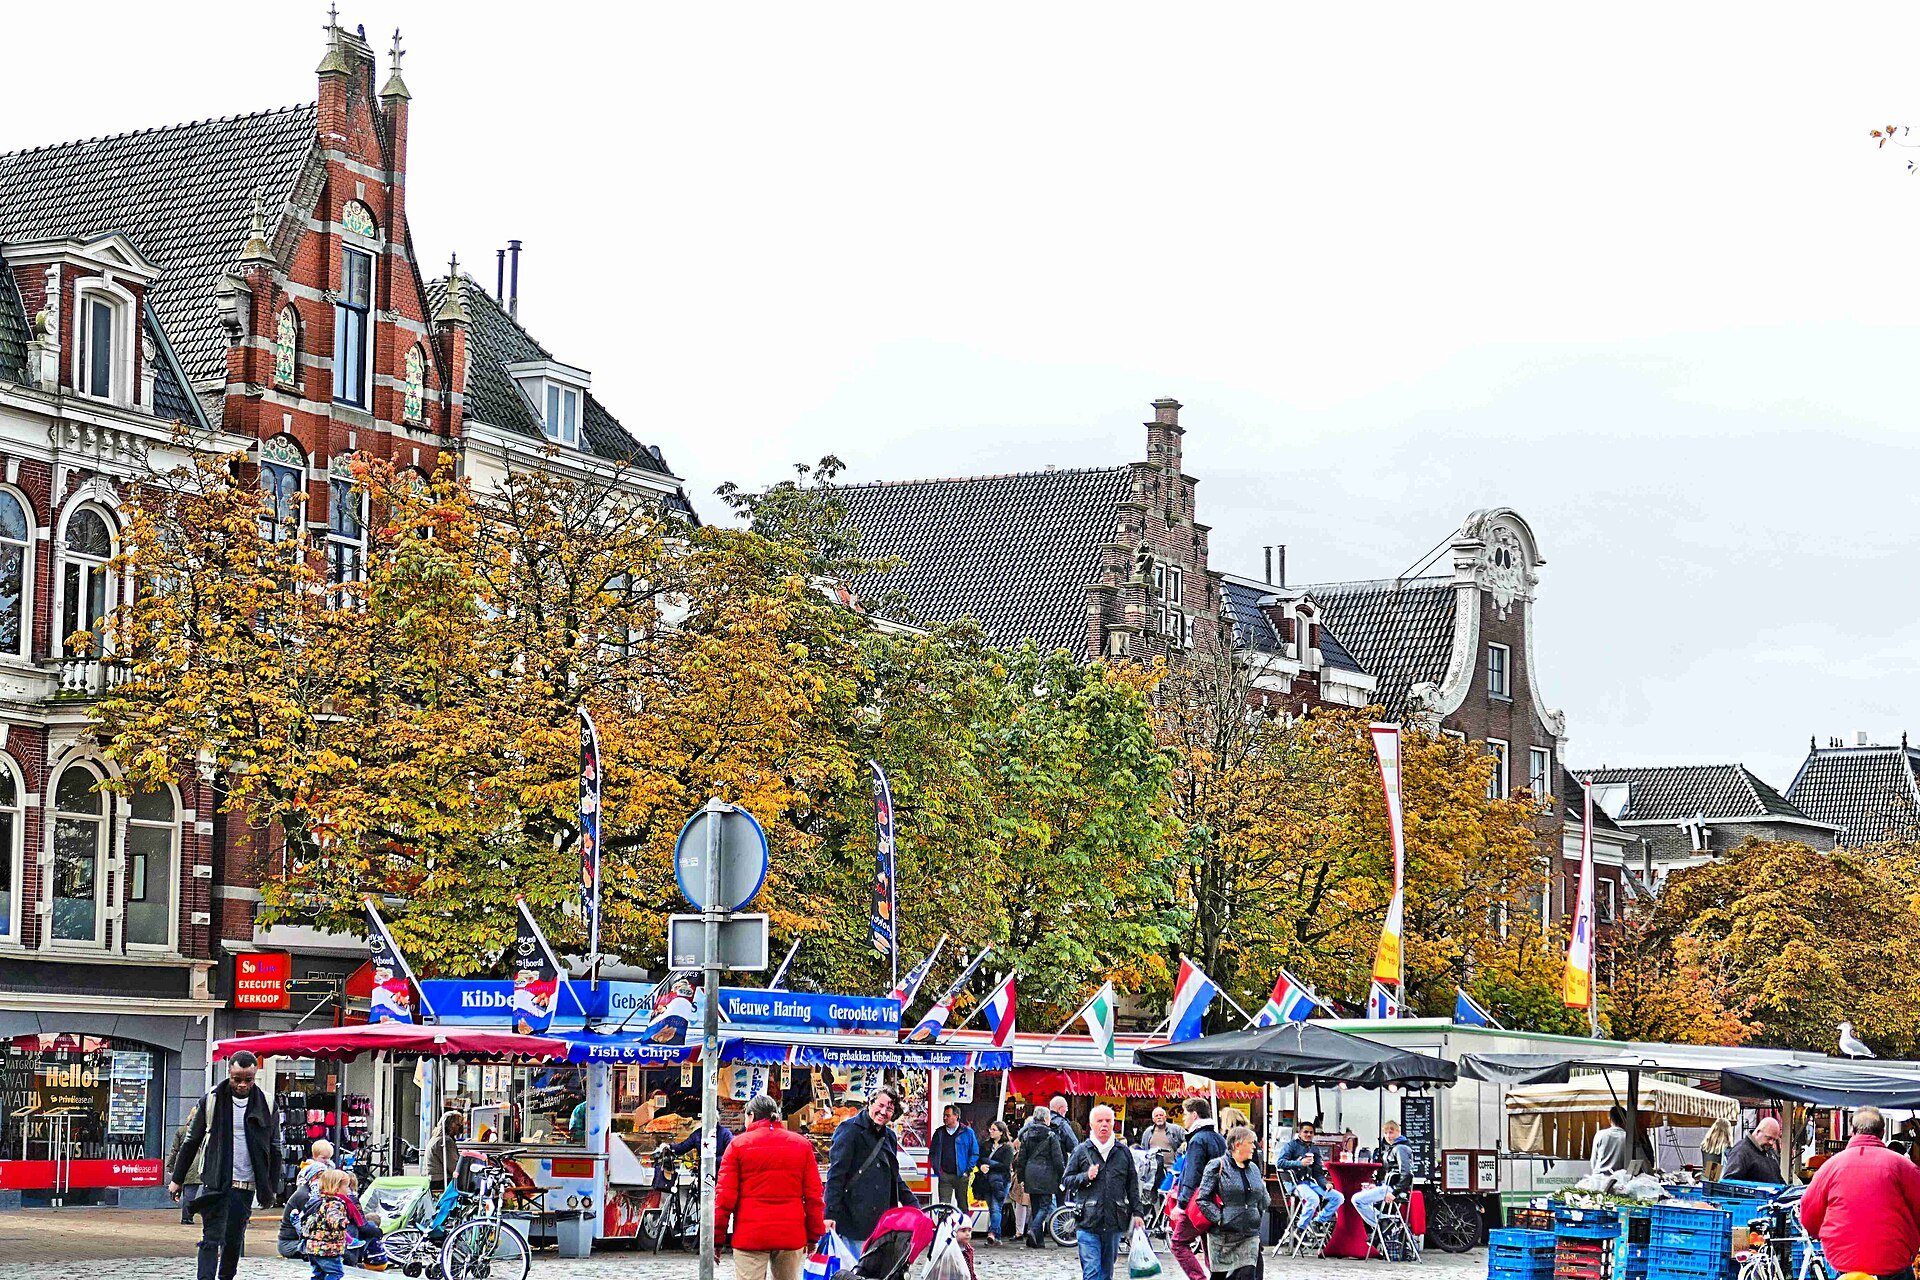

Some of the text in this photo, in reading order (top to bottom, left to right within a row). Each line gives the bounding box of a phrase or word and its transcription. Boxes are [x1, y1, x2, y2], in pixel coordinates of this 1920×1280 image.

[242, 960, 256, 974] So
[238, 980, 281, 989] EXECUTIE
[238, 994, 280, 1003] VERKOOP
[461, 990, 514, 1008] Kibbe
[729, 998, 898, 1023] Nieuwe Haring Gerookte Vis
[589, 1045, 680, 1061] Fish & Chips
[822, 1048, 839, 1060] Vers
[839, 1050, 870, 1063] gebakken
[871, 1050, 902, 1065] kibbeling
[45, 1063, 99, 1088] Hello!
[1478, 1160, 1495, 1170] COFFEE
[1485, 1172, 1493, 1182] GO
